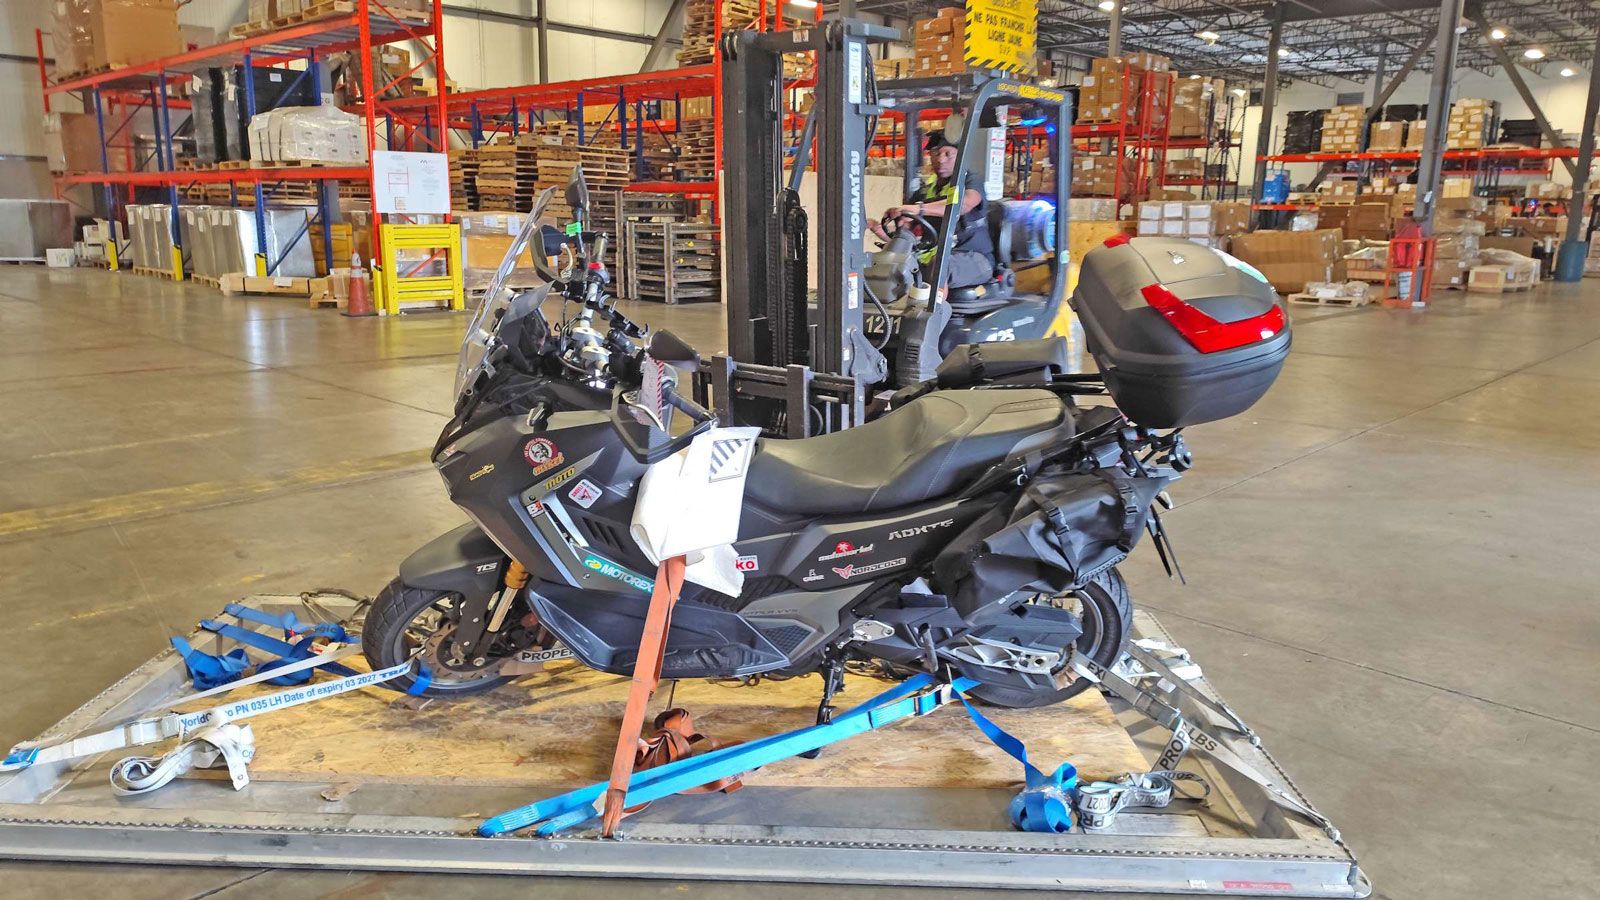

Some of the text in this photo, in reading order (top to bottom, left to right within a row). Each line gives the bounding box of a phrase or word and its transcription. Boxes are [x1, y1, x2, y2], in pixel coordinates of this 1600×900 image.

[986, 13, 998, 26] PAS
[849, 150, 861, 240] KOMATSU
[866, 315, 902, 334] 121
[545, 467, 577, 491] MOTO
[600, 563, 654, 593] MOTOREX
[235, 703, 249, 716] PN
[251, 699, 268, 713] 035
[269, 695, 283, 708] LH
[283, 691, 304, 704] Date
[306, 687, 316, 698] of
[317, 681, 344, 696] expiry
[345, 678, 356, 688] 03
[357, 674, 378, 686] 2027
[1188, 727, 1218, 752] LBS
